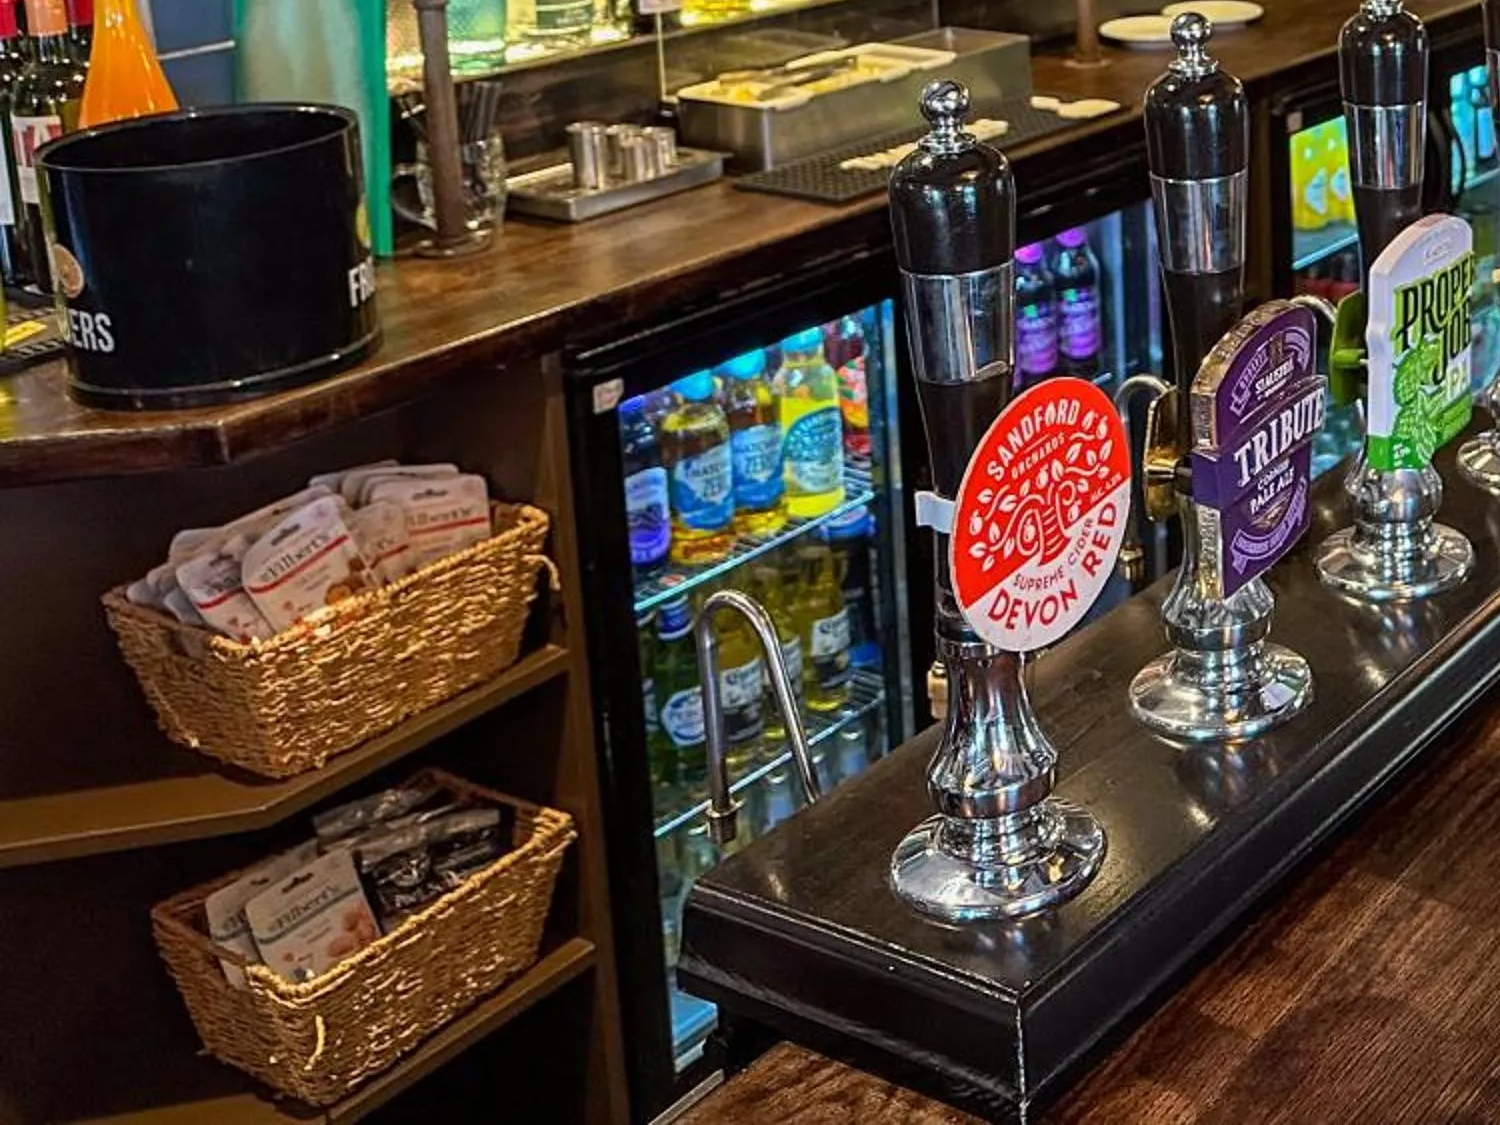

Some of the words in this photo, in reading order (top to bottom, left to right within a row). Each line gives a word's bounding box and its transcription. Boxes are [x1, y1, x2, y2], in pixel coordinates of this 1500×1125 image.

[987, 398, 1082, 482] SANDFORD
[1011, 432, 1066, 480] ORCHARDS
[1233, 386, 1327, 490] TRIBUTE
[1250, 480, 1276, 515] PALE
[1274, 468, 1296, 497] ALE
[987, 579, 1080, 630] DEVON
[1082, 502, 1118, 577] RED
[1013, 566, 1065, 591] SUPREME
[1067, 516, 1094, 565] CIDER
